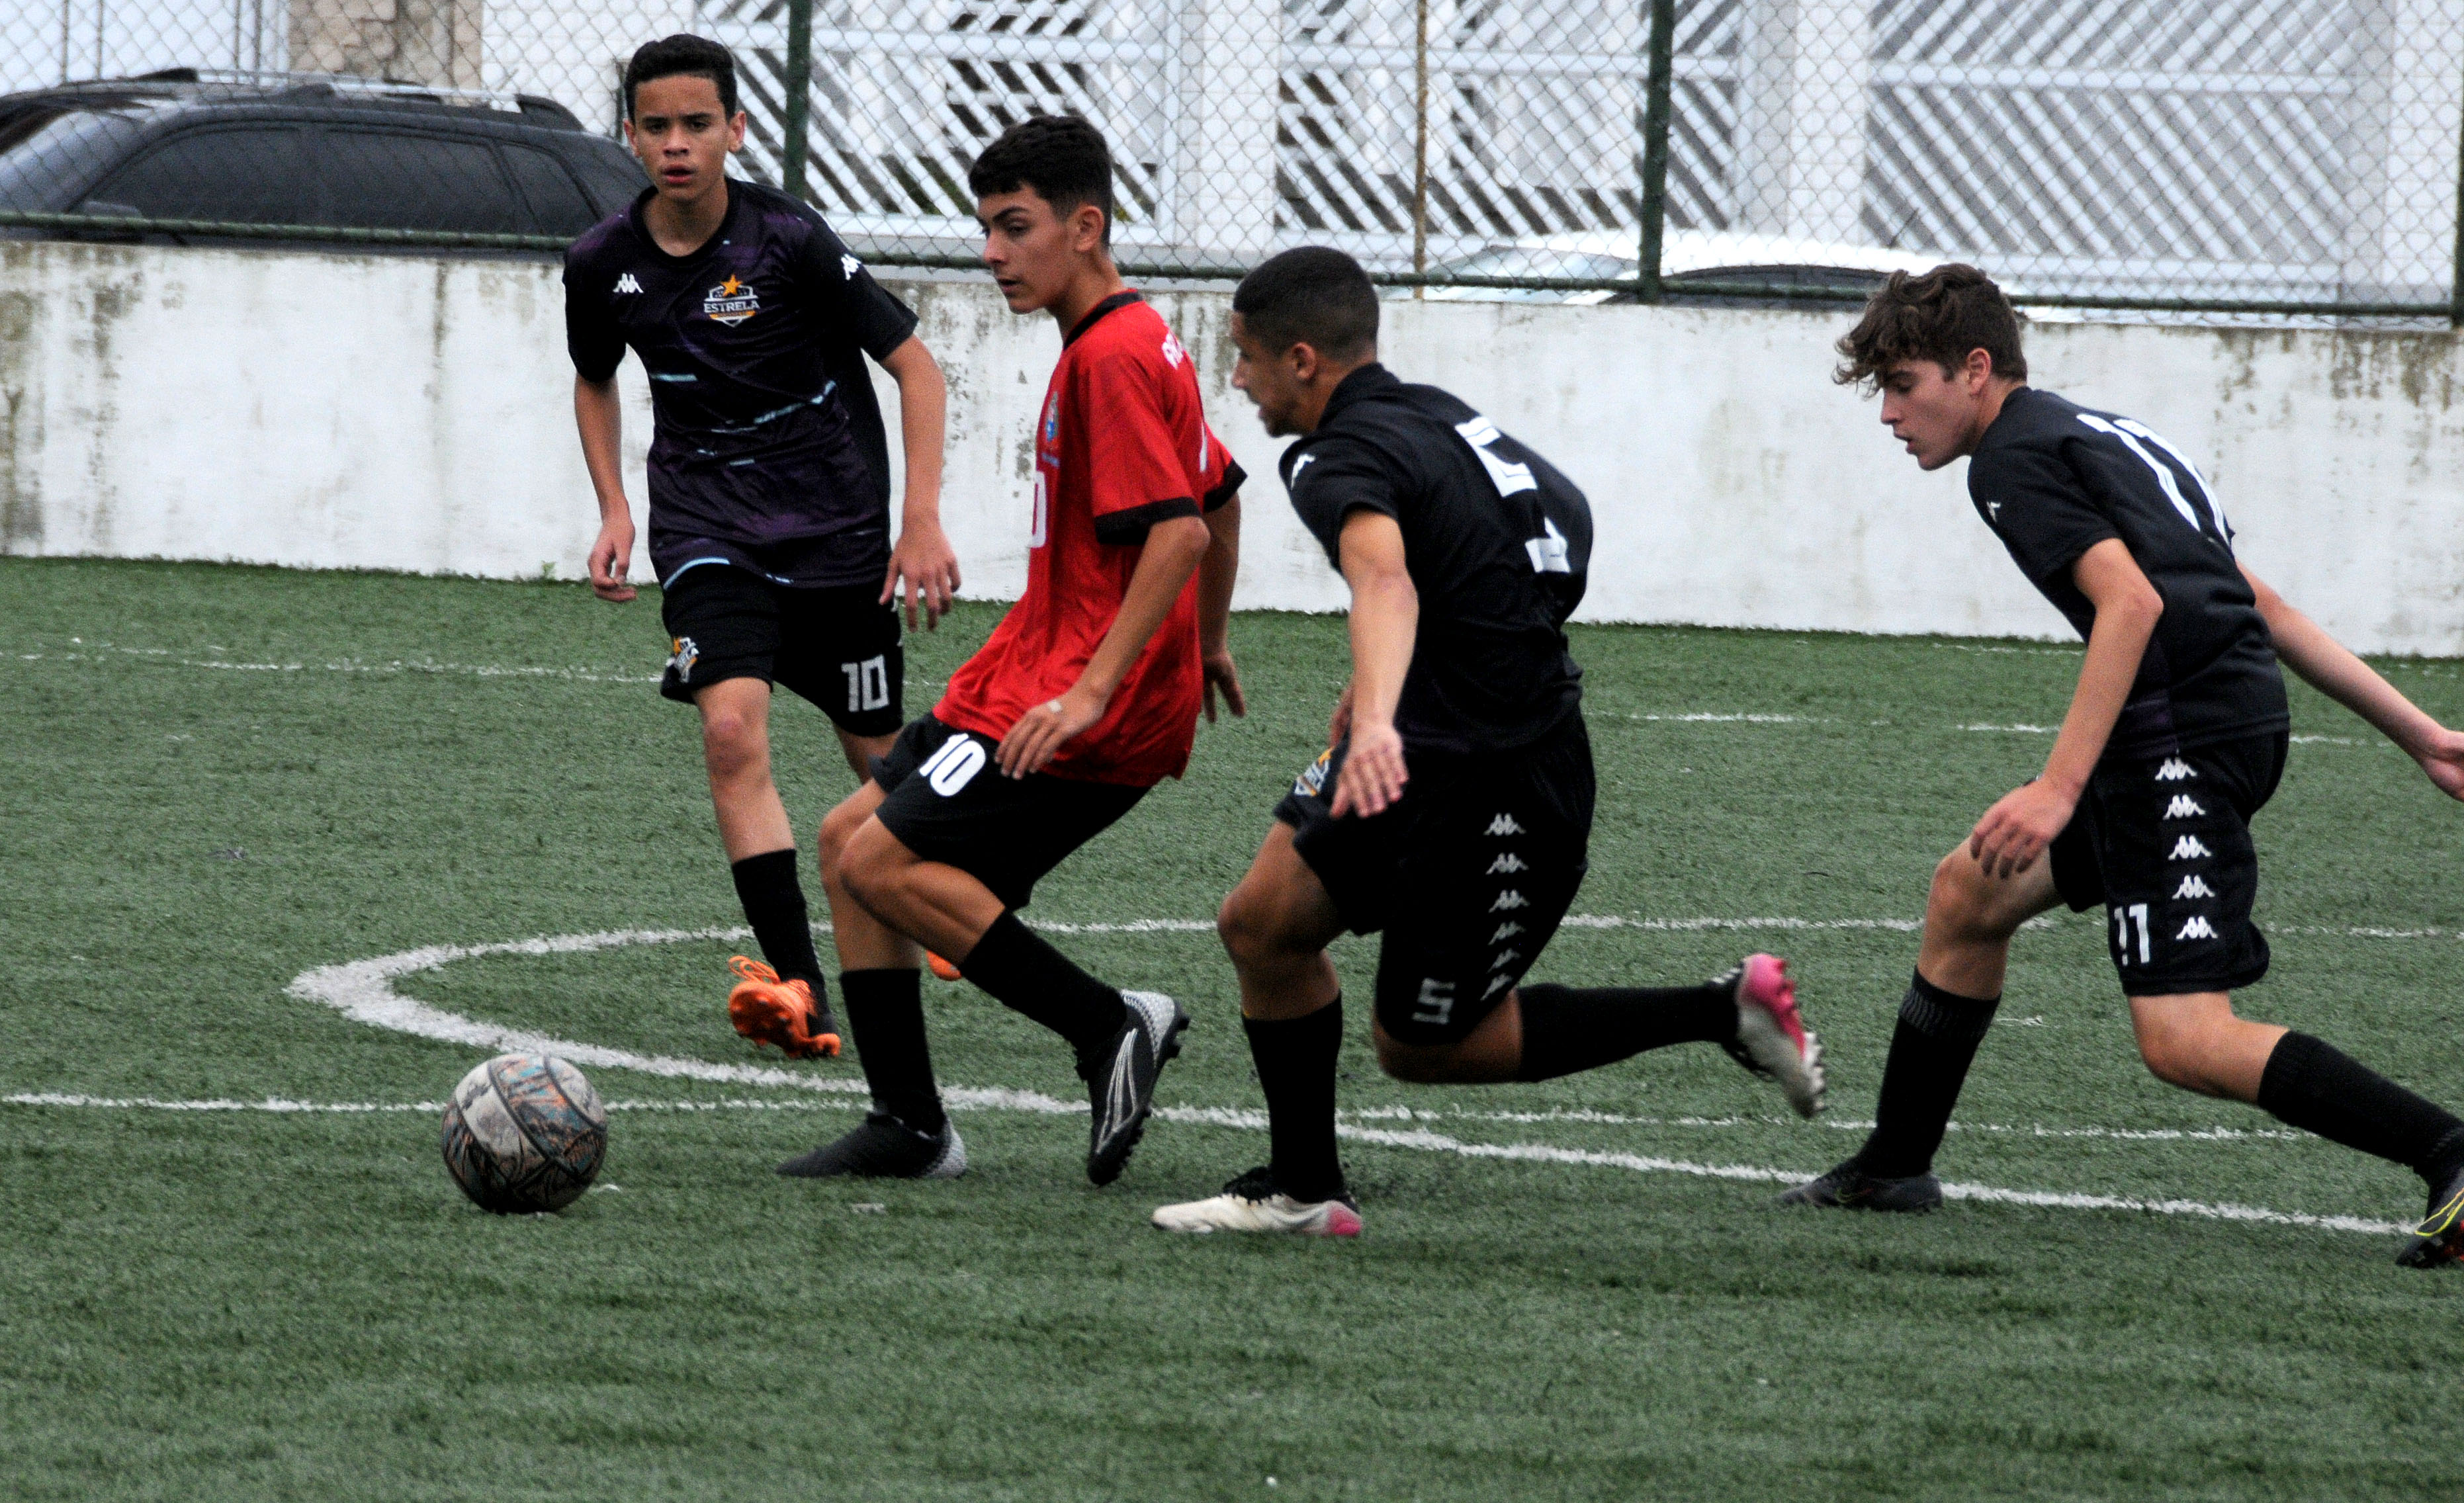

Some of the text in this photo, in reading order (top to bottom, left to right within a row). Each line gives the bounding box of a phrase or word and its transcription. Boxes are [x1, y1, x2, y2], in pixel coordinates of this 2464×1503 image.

[704, 300, 760, 313] ESTRELA
[841, 654, 890, 712] 10
[918, 733, 986, 796] 10
[2114, 903, 2150, 966] 11
[1412, 977, 1455, 1025] 5
